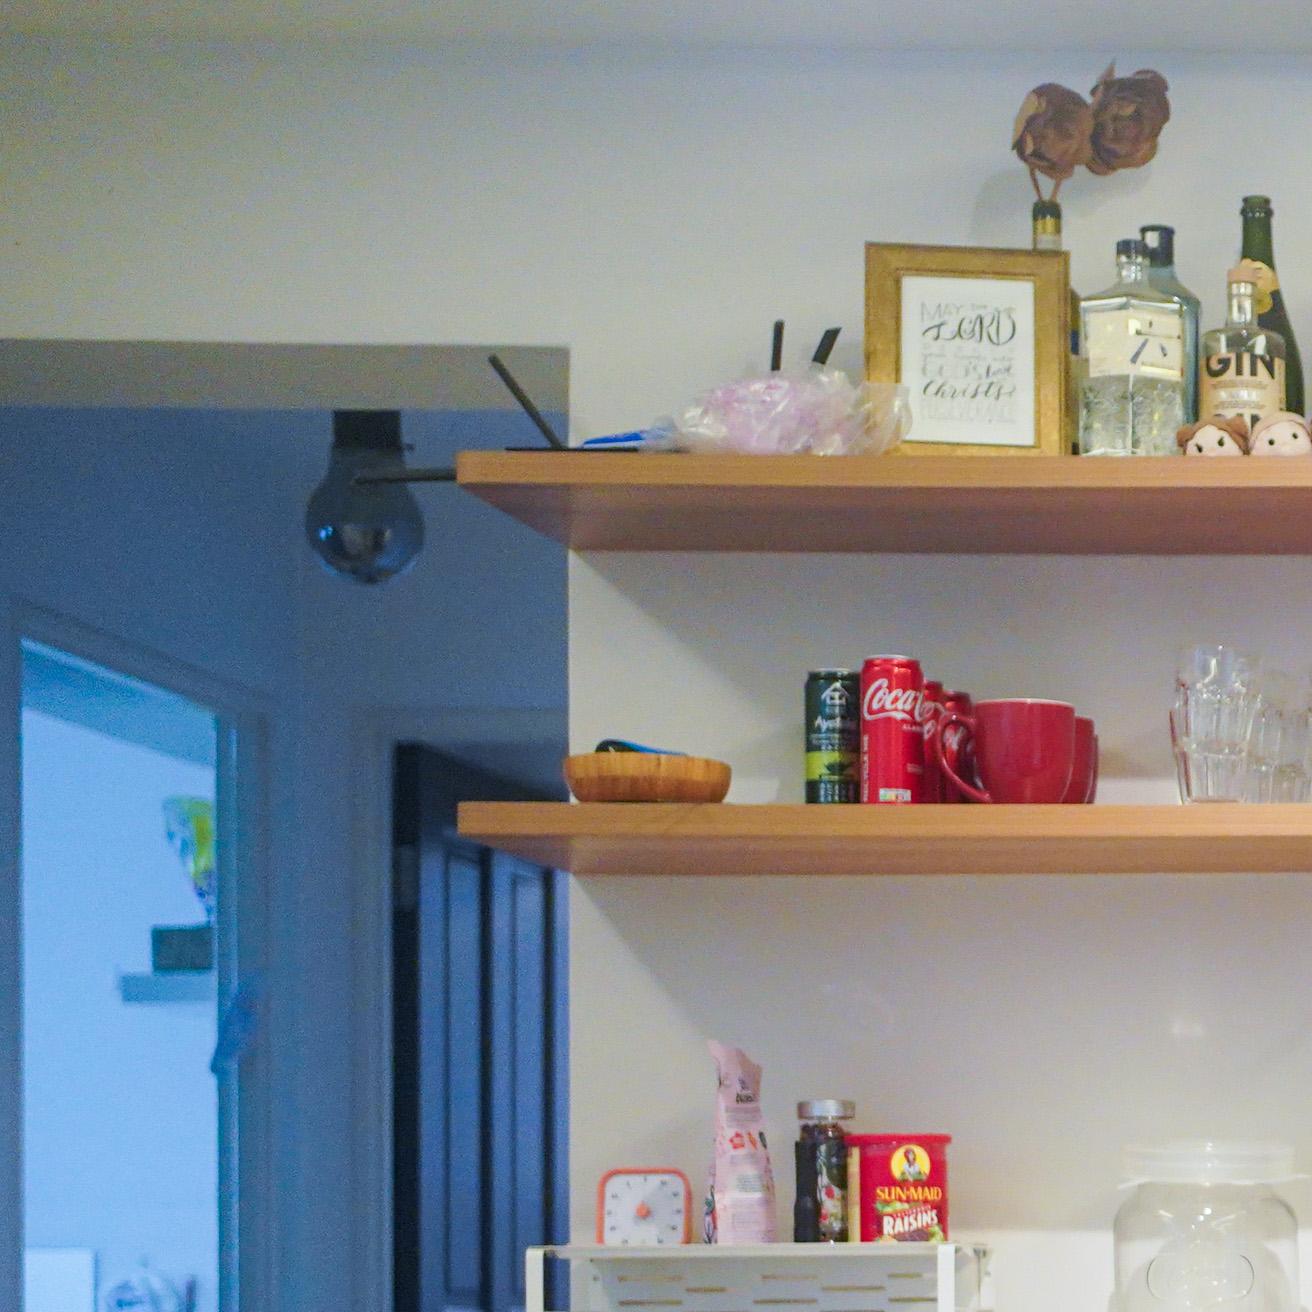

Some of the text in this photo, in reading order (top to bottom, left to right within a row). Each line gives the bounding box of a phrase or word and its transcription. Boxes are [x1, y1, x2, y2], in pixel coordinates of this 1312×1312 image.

[921, 307, 1017, 346] LORD
[1206, 352, 1275, 380] GIN
[876, 1186, 942, 1201] SUN-MAID
[883, 1209, 939, 1236] RAISINS
